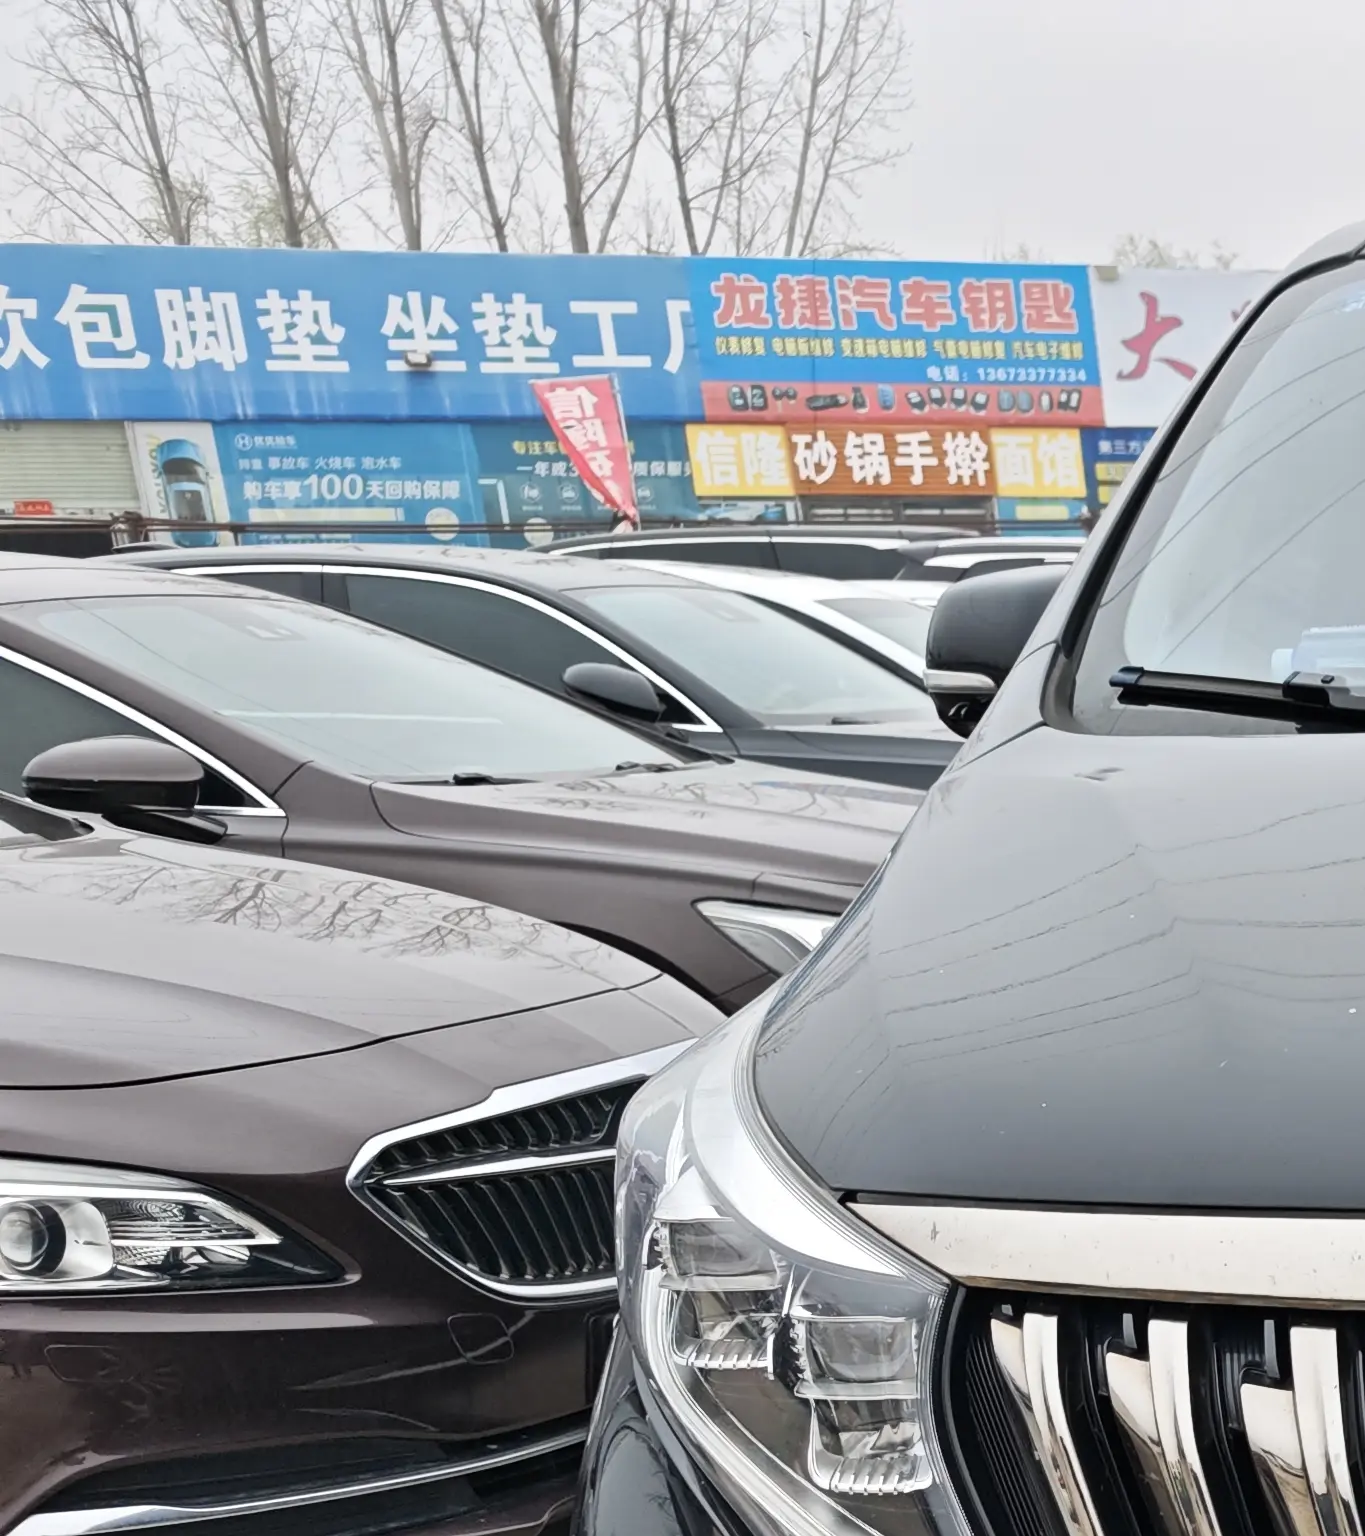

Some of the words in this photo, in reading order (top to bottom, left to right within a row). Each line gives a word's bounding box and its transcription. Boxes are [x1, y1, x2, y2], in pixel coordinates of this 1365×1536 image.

[710, 272, 1080, 334] 龙捷汽车钥匙
[268, 456, 309, 471] 事故车
